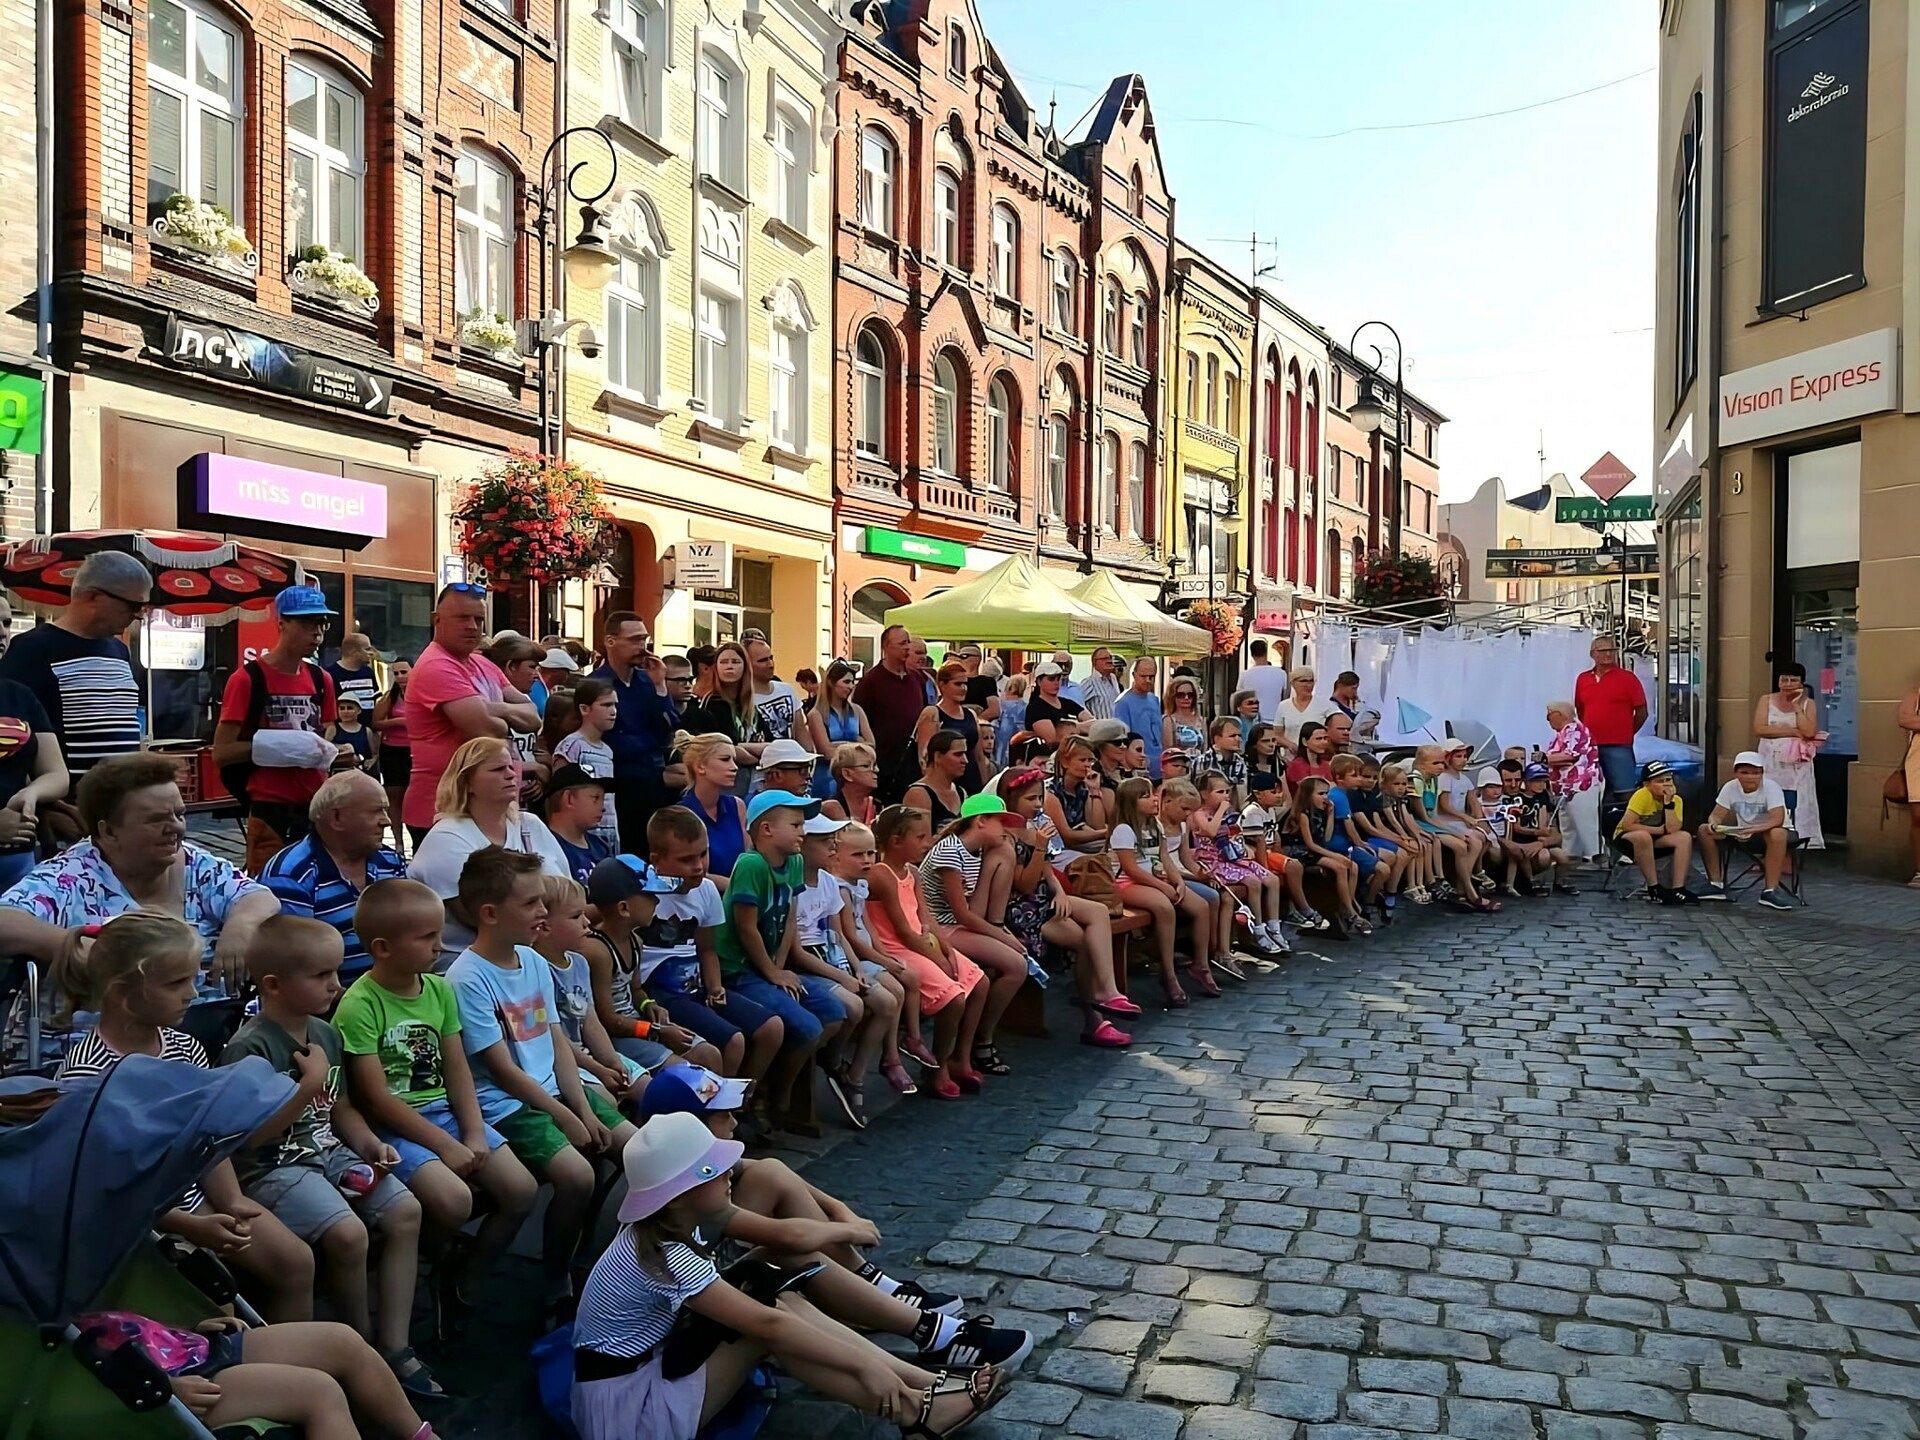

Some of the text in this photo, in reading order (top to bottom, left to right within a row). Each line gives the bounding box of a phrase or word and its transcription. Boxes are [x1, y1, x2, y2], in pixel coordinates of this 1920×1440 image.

[1724, 361, 1882, 418] Vision Express
[238, 478, 365, 520] miss angel
[1732, 471, 1742, 494] 3
